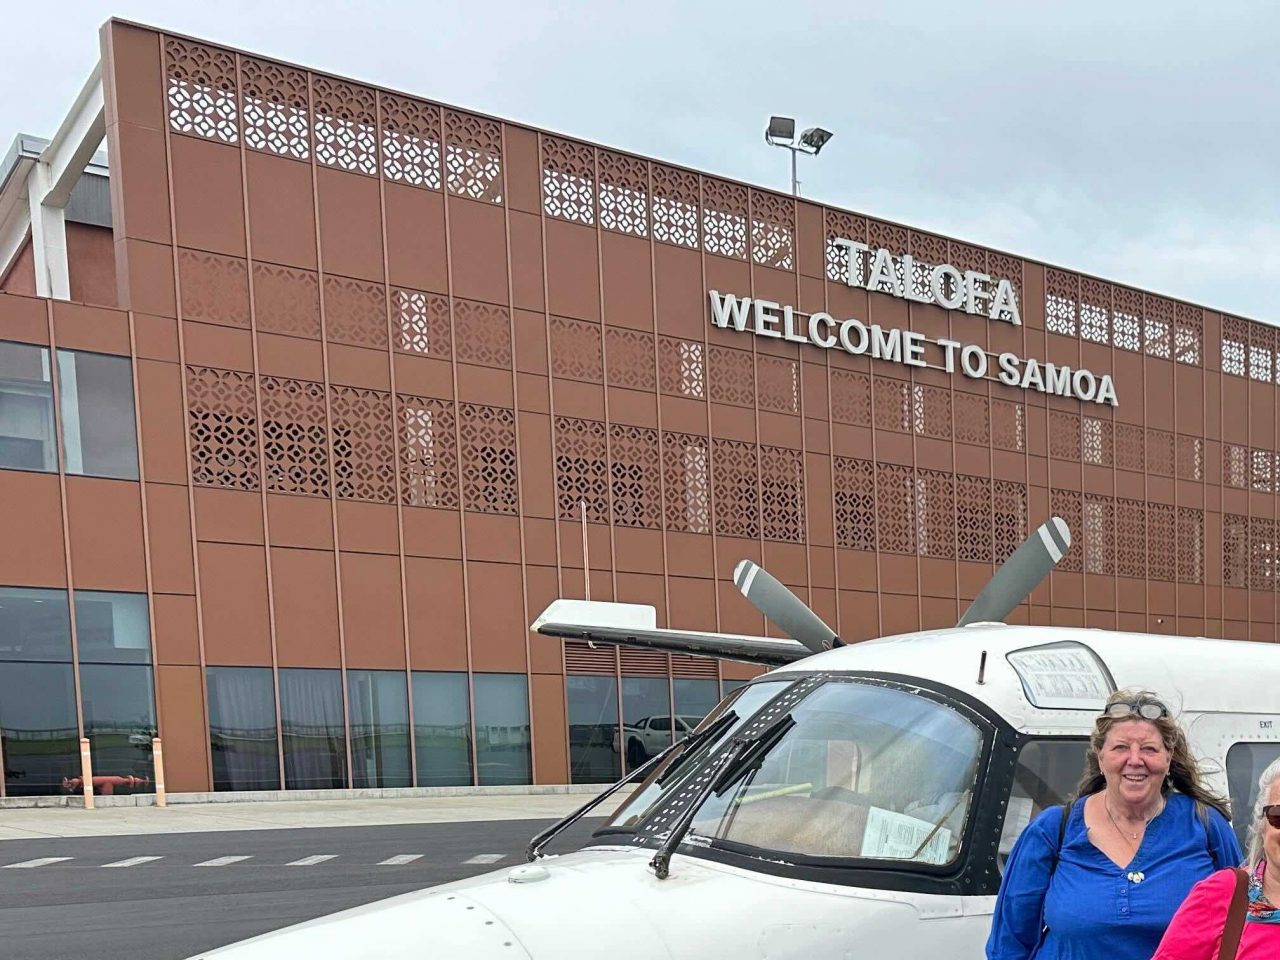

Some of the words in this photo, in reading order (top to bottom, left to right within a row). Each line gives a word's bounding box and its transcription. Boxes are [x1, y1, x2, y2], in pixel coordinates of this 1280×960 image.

[834, 238, 1022, 326] TALOFA
[709, 289, 927, 368] WELCOME
[937, 338, 988, 379] TO
[998, 352, 1119, 407] SAMOA
[1259, 720, 1273, 729] EXIT
